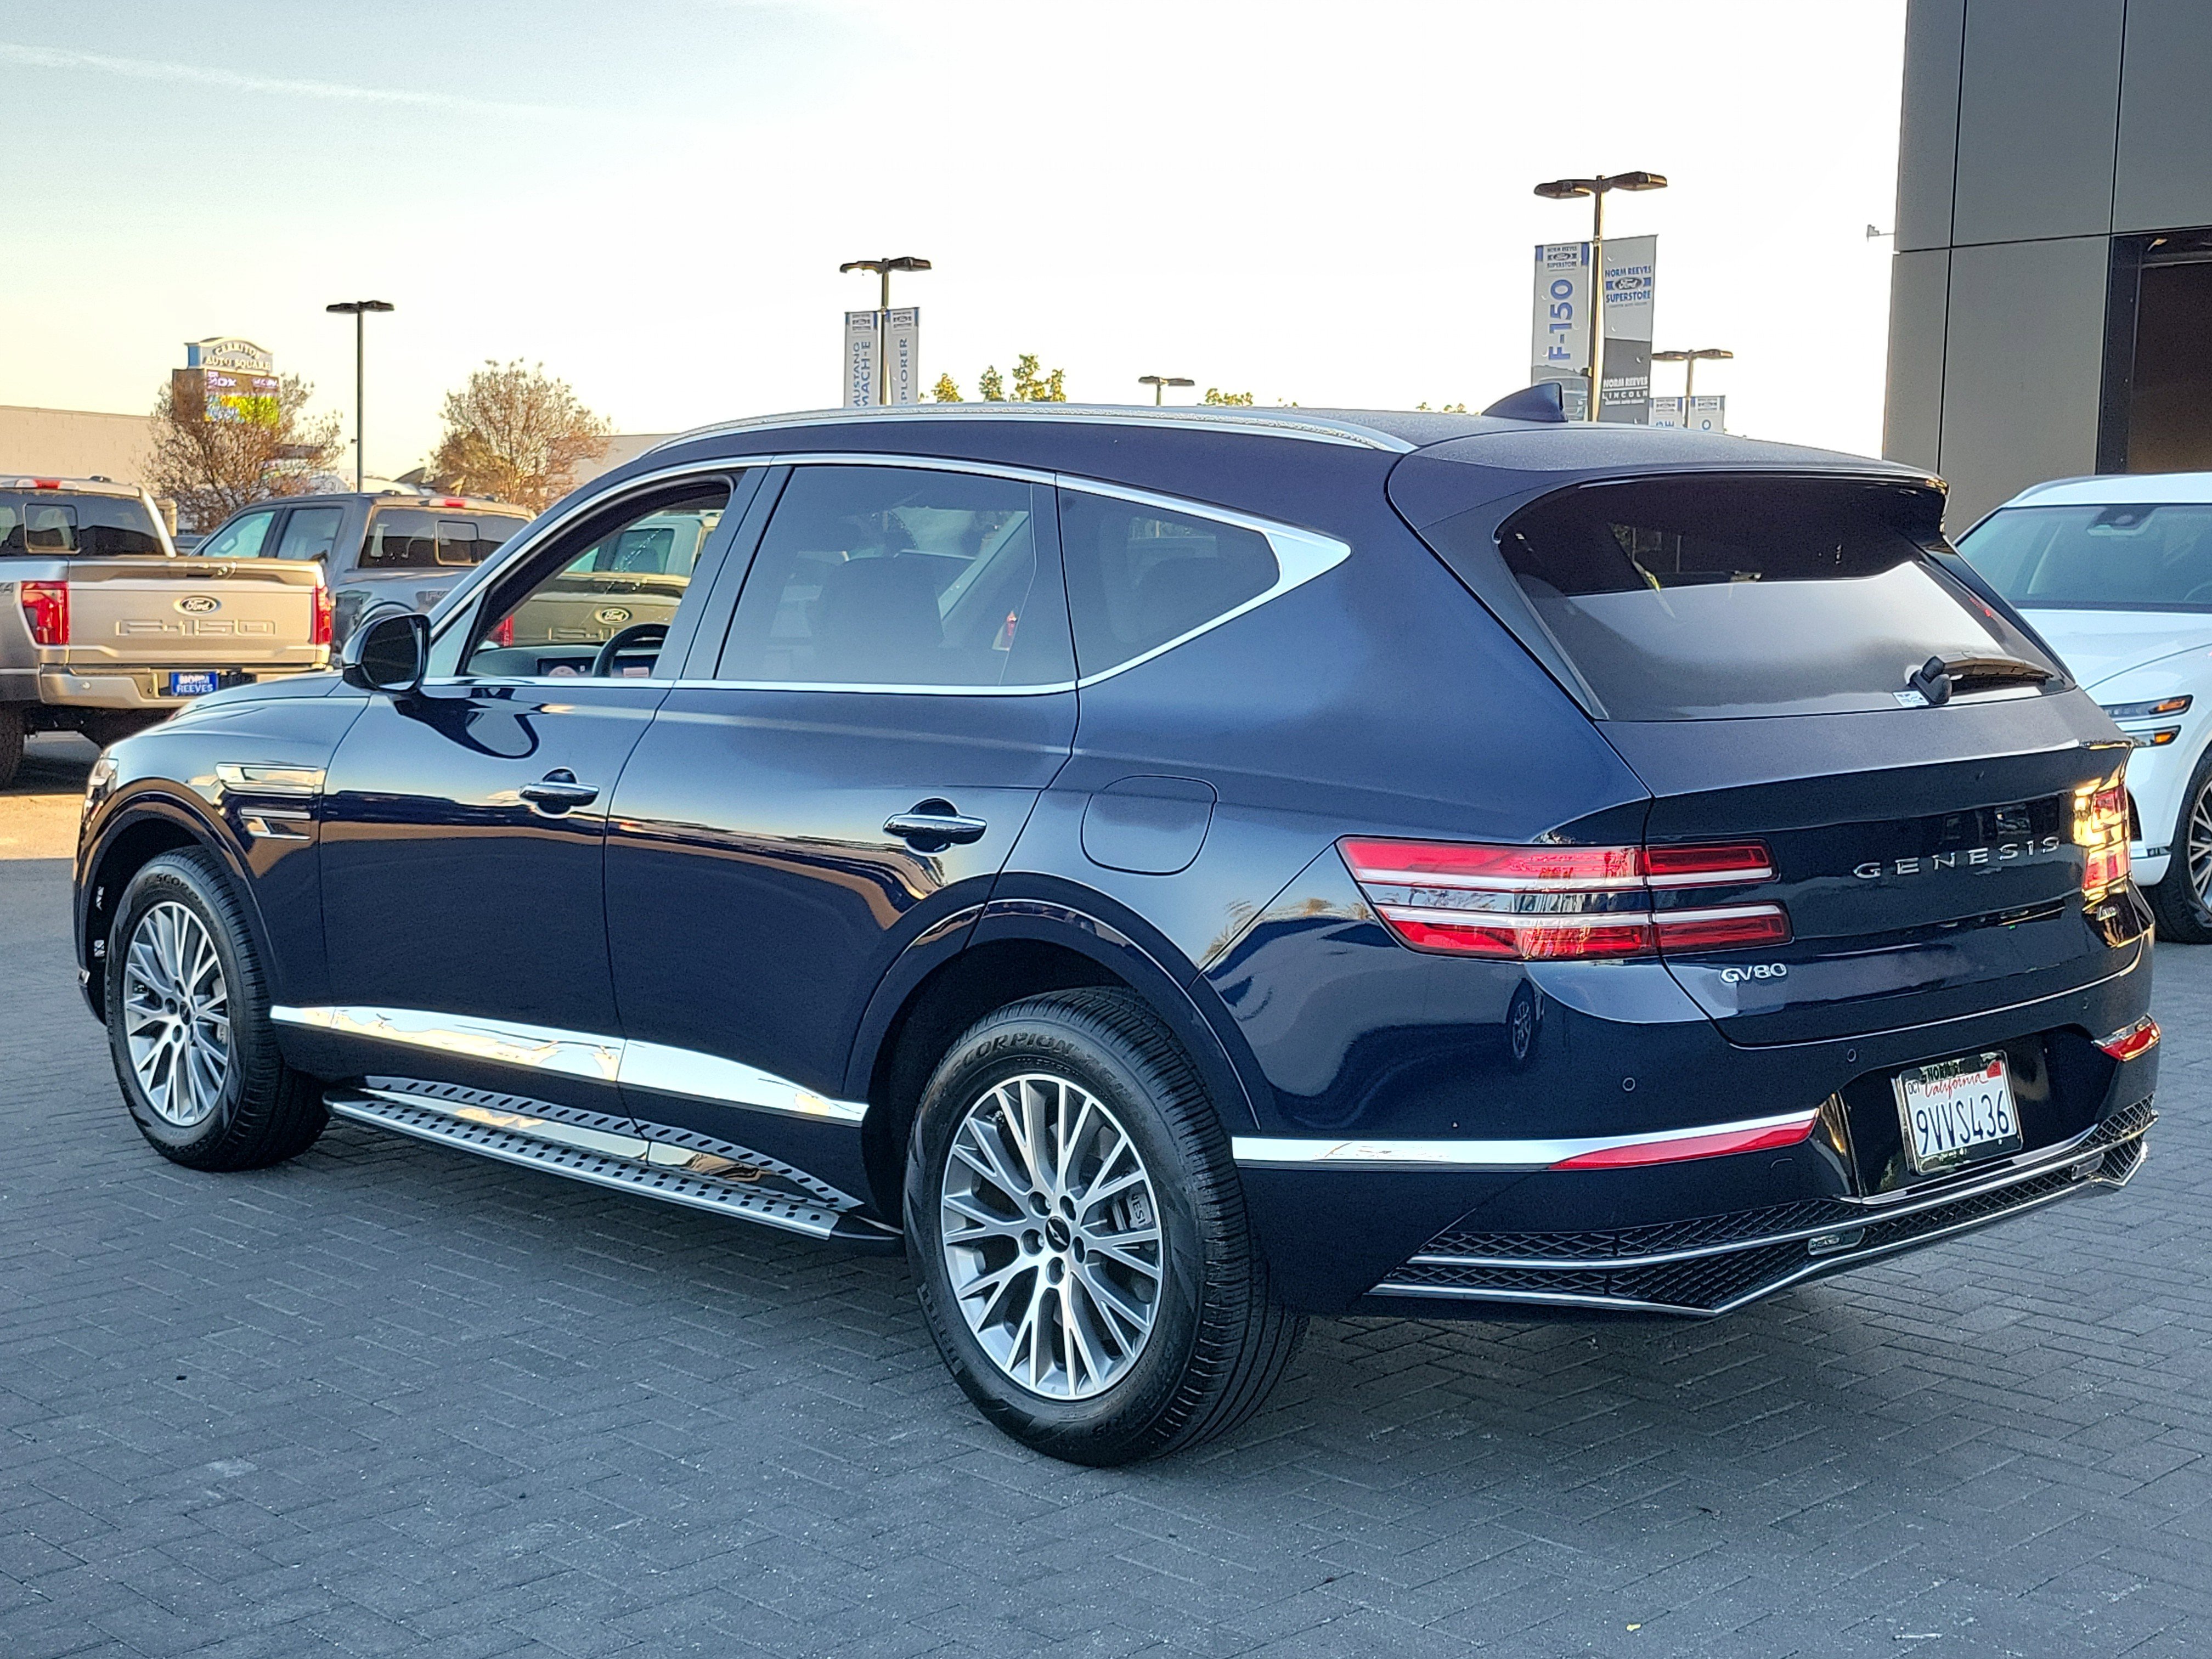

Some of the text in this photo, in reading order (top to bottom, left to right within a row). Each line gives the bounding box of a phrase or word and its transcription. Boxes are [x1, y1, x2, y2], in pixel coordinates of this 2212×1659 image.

[1605, 266, 1651, 278] NORM REEVES
[1605, 290, 1651, 303] SUPERSTORE
[1548, 279, 1573, 360] F-150
[202, 356, 271, 370] AUTO SQUARE
[899, 338, 908, 405] PLORER
[1602, 390, 1648, 400] LINCOLN
[185, 600, 211, 611] Ford
[115, 619, 275, 636] F-150
[176, 684, 214, 693] REEVES
[1853, 836, 2059, 879] GENESIS
[1720, 963, 1787, 983] GV80
[1925, 1073, 1989, 1099] California
[1916, 1090, 2010, 1155] 9VVS436
